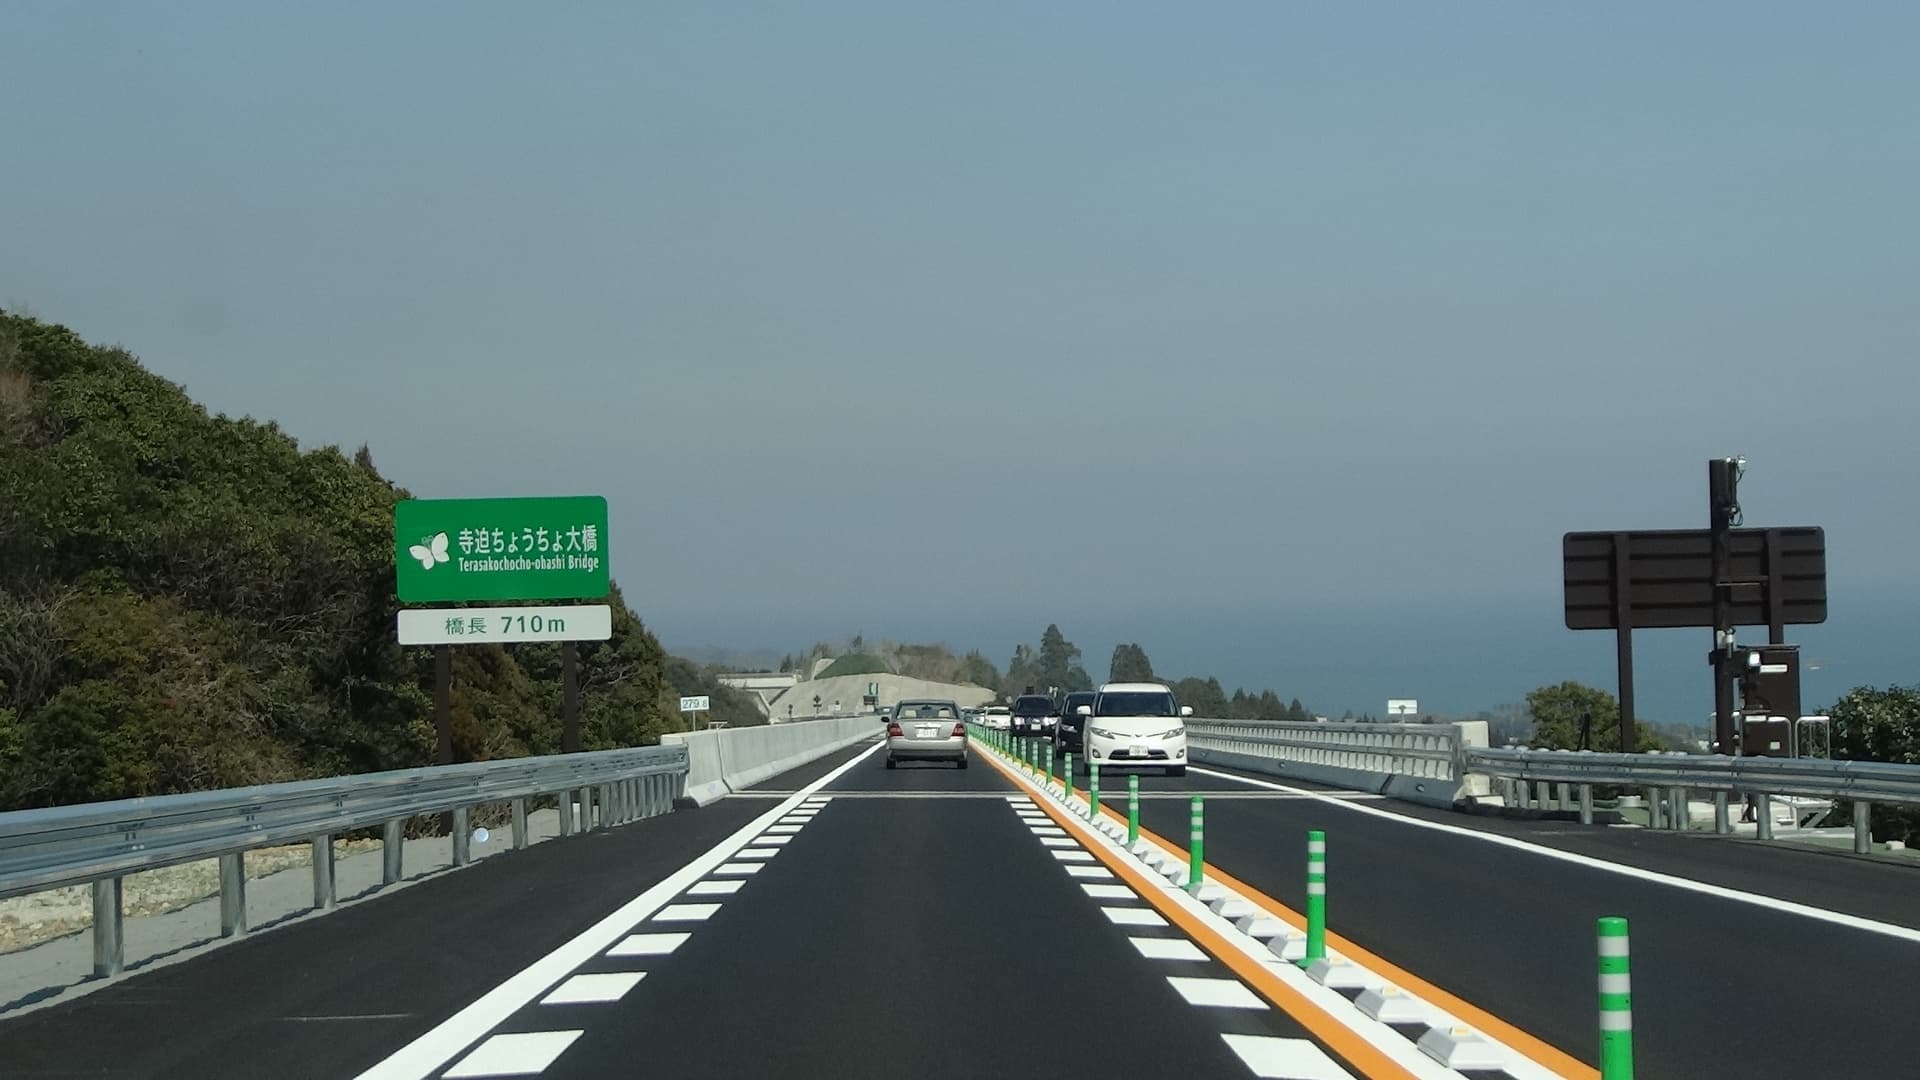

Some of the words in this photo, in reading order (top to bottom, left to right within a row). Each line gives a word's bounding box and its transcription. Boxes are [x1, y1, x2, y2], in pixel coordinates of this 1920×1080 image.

[458, 524, 598, 554] 寺迫ちょうちょ大橋
[458, 555, 566, 572] Terasakochocho-ohashi
[568, 555, 599, 573] Bridge
[445, 617, 487, 635] 橋長
